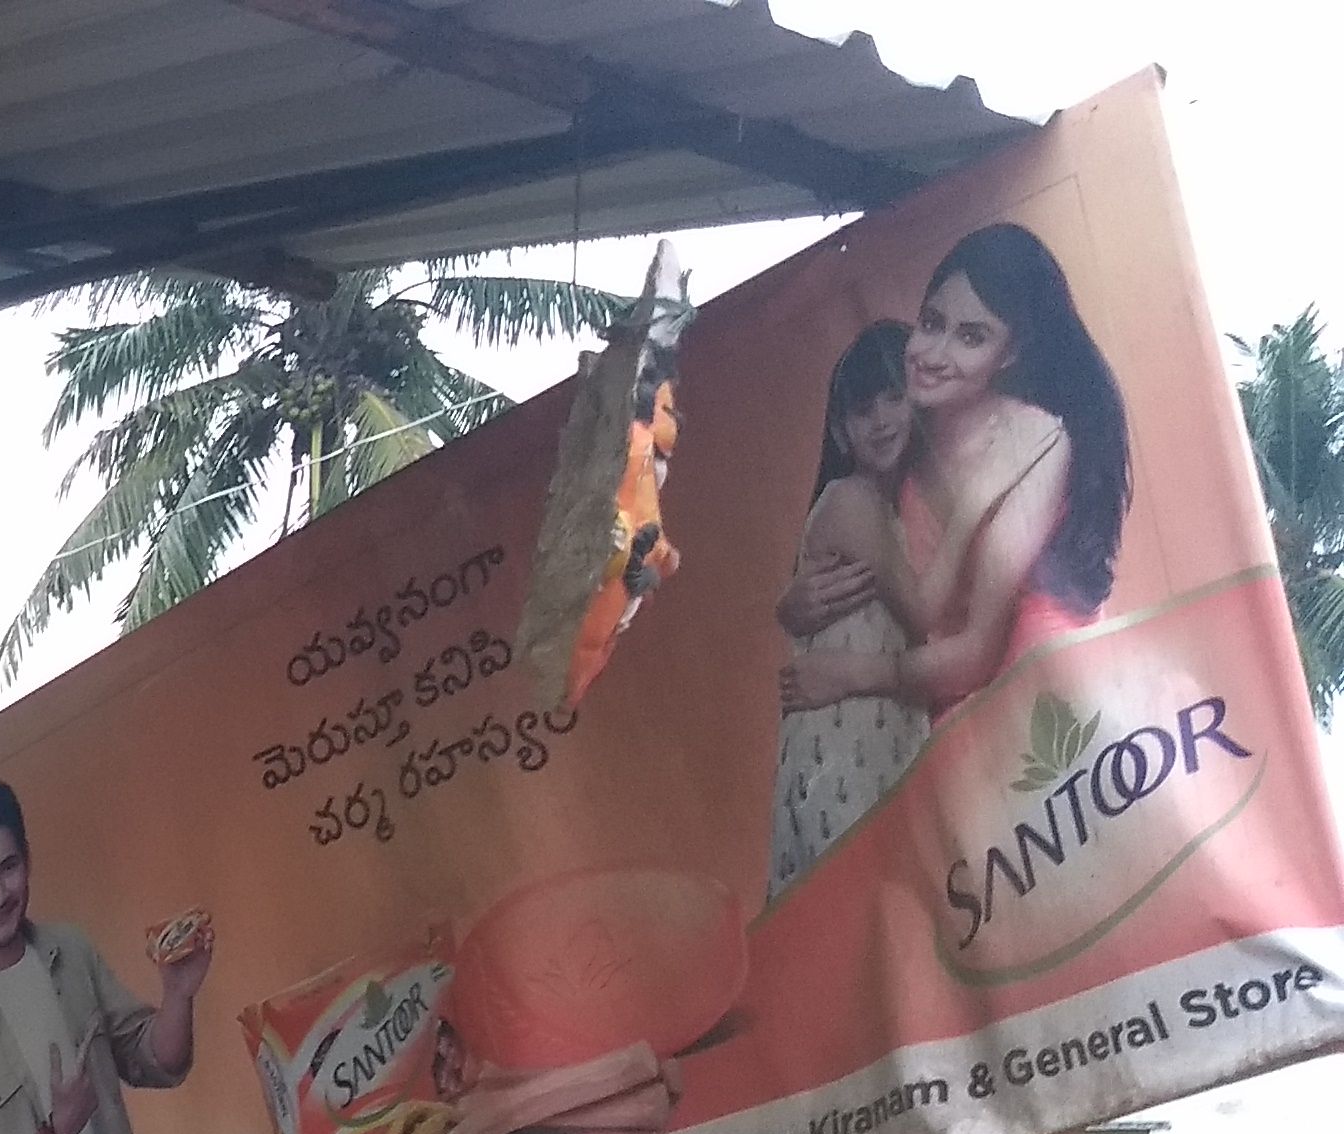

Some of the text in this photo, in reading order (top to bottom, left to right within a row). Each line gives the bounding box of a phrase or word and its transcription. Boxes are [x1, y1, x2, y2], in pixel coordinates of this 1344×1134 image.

[286, 543, 507, 687] యవ్వనంగా
[946, 695, 1254, 951] SANTOOR
[330, 981, 431, 1110] SANTOOR
[967, 1064, 998, 1099] &
[1004, 1002, 1172, 1086] General
[1179, 963, 1325, 1028] Store
